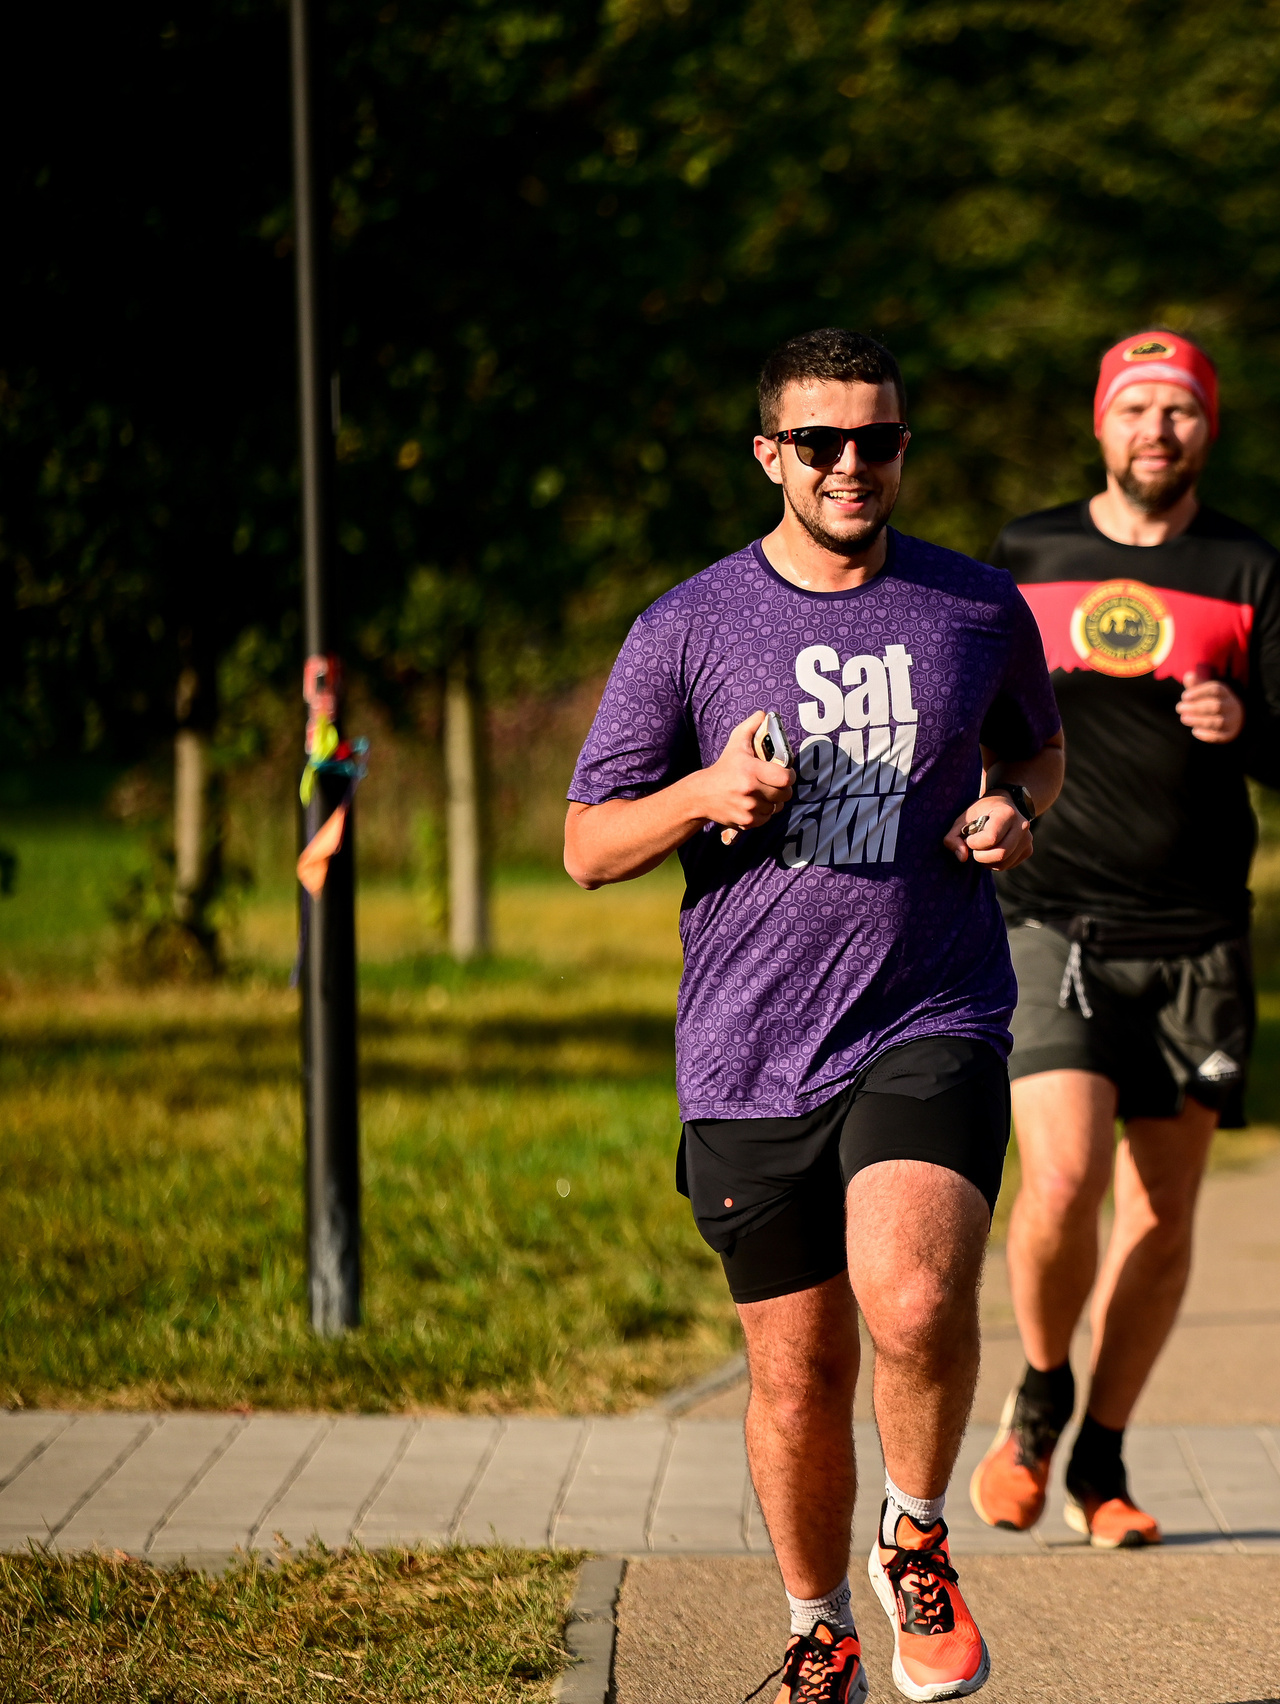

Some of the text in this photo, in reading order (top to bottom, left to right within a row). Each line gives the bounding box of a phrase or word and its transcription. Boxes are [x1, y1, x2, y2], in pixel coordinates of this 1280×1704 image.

[795, 644, 918, 735] Sat
[797, 724, 917, 802] 9AM
[781, 794, 905, 869] 5KM
